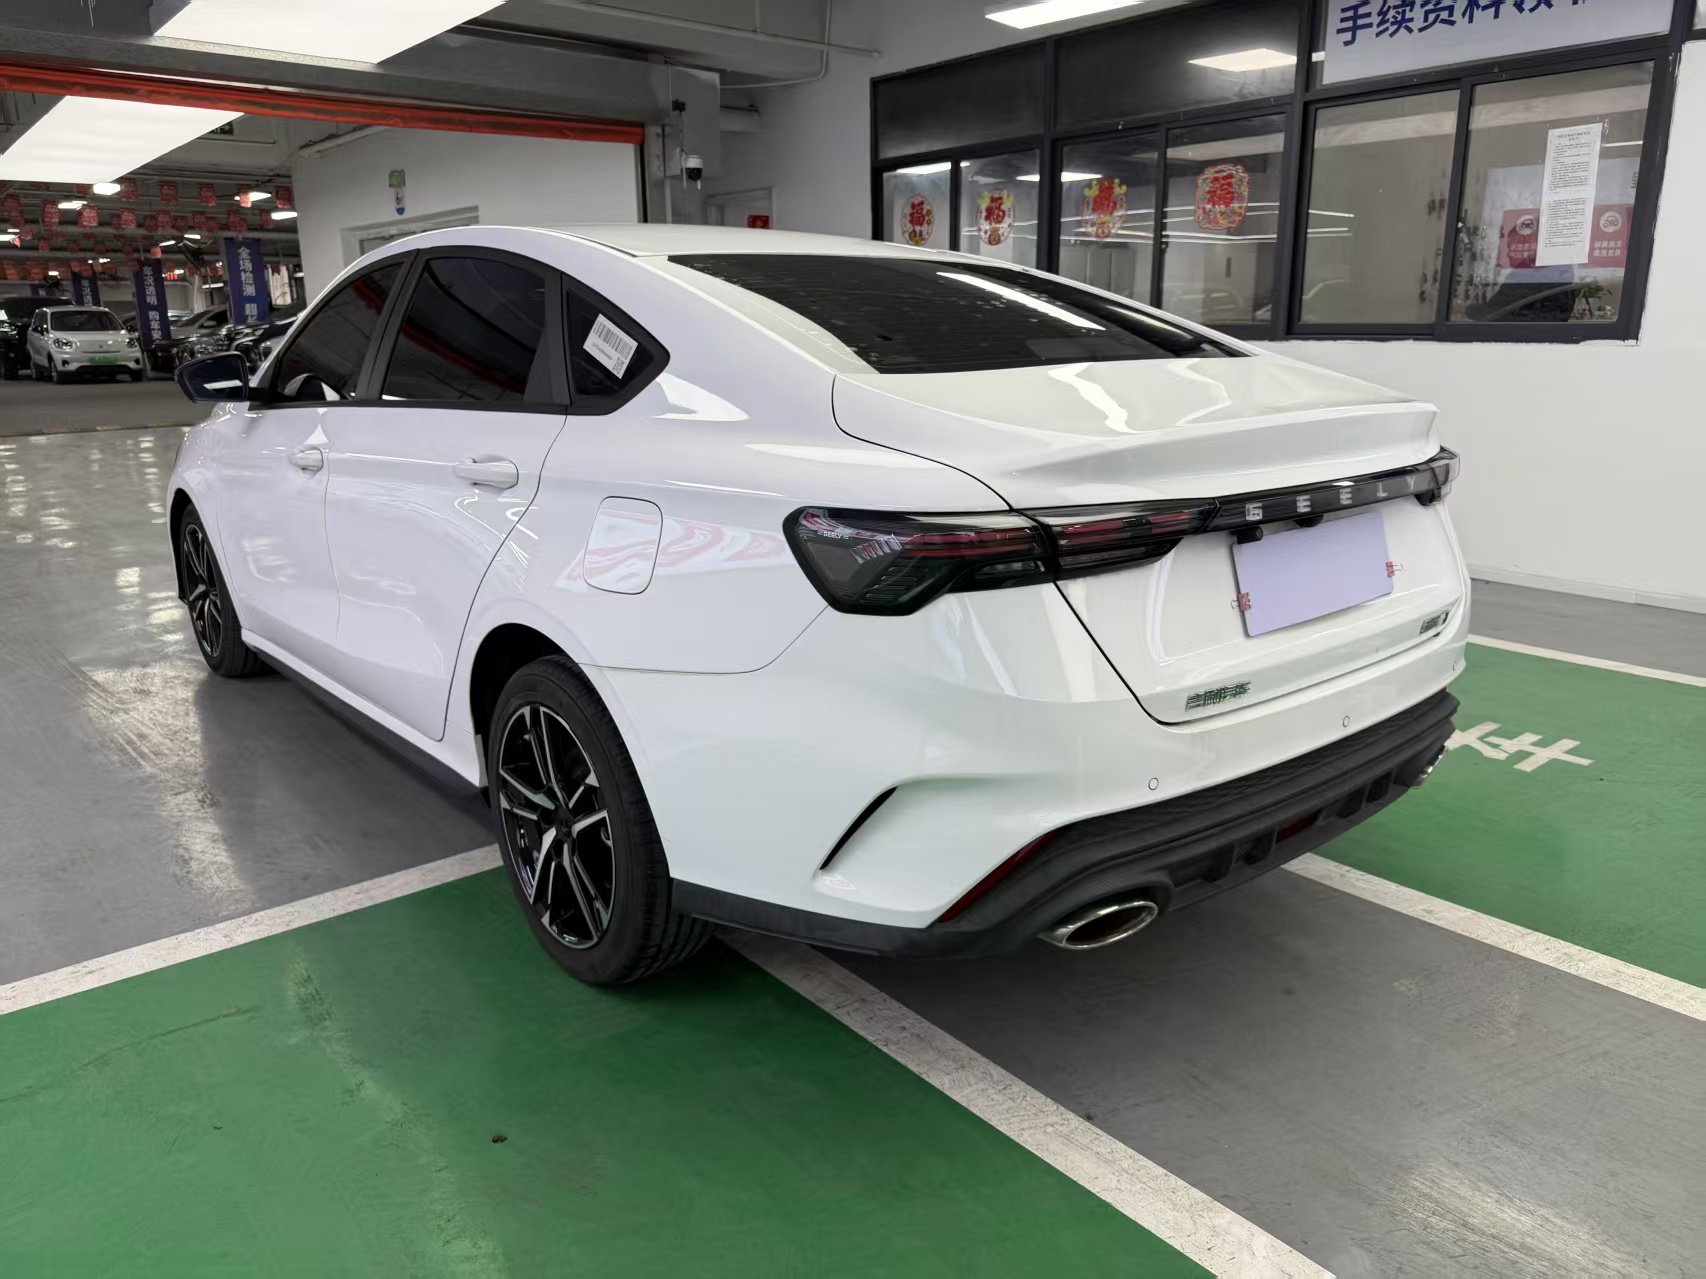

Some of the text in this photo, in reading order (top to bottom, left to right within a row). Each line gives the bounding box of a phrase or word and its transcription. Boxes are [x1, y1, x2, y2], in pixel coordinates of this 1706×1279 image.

[908, 200, 925, 227] 福
[984, 195, 1006, 225] 福
[142, 266, 158, 306] 车况透明
[237, 246, 256, 297] 全场检测
[1245, 476, 1415, 521] GEELY
